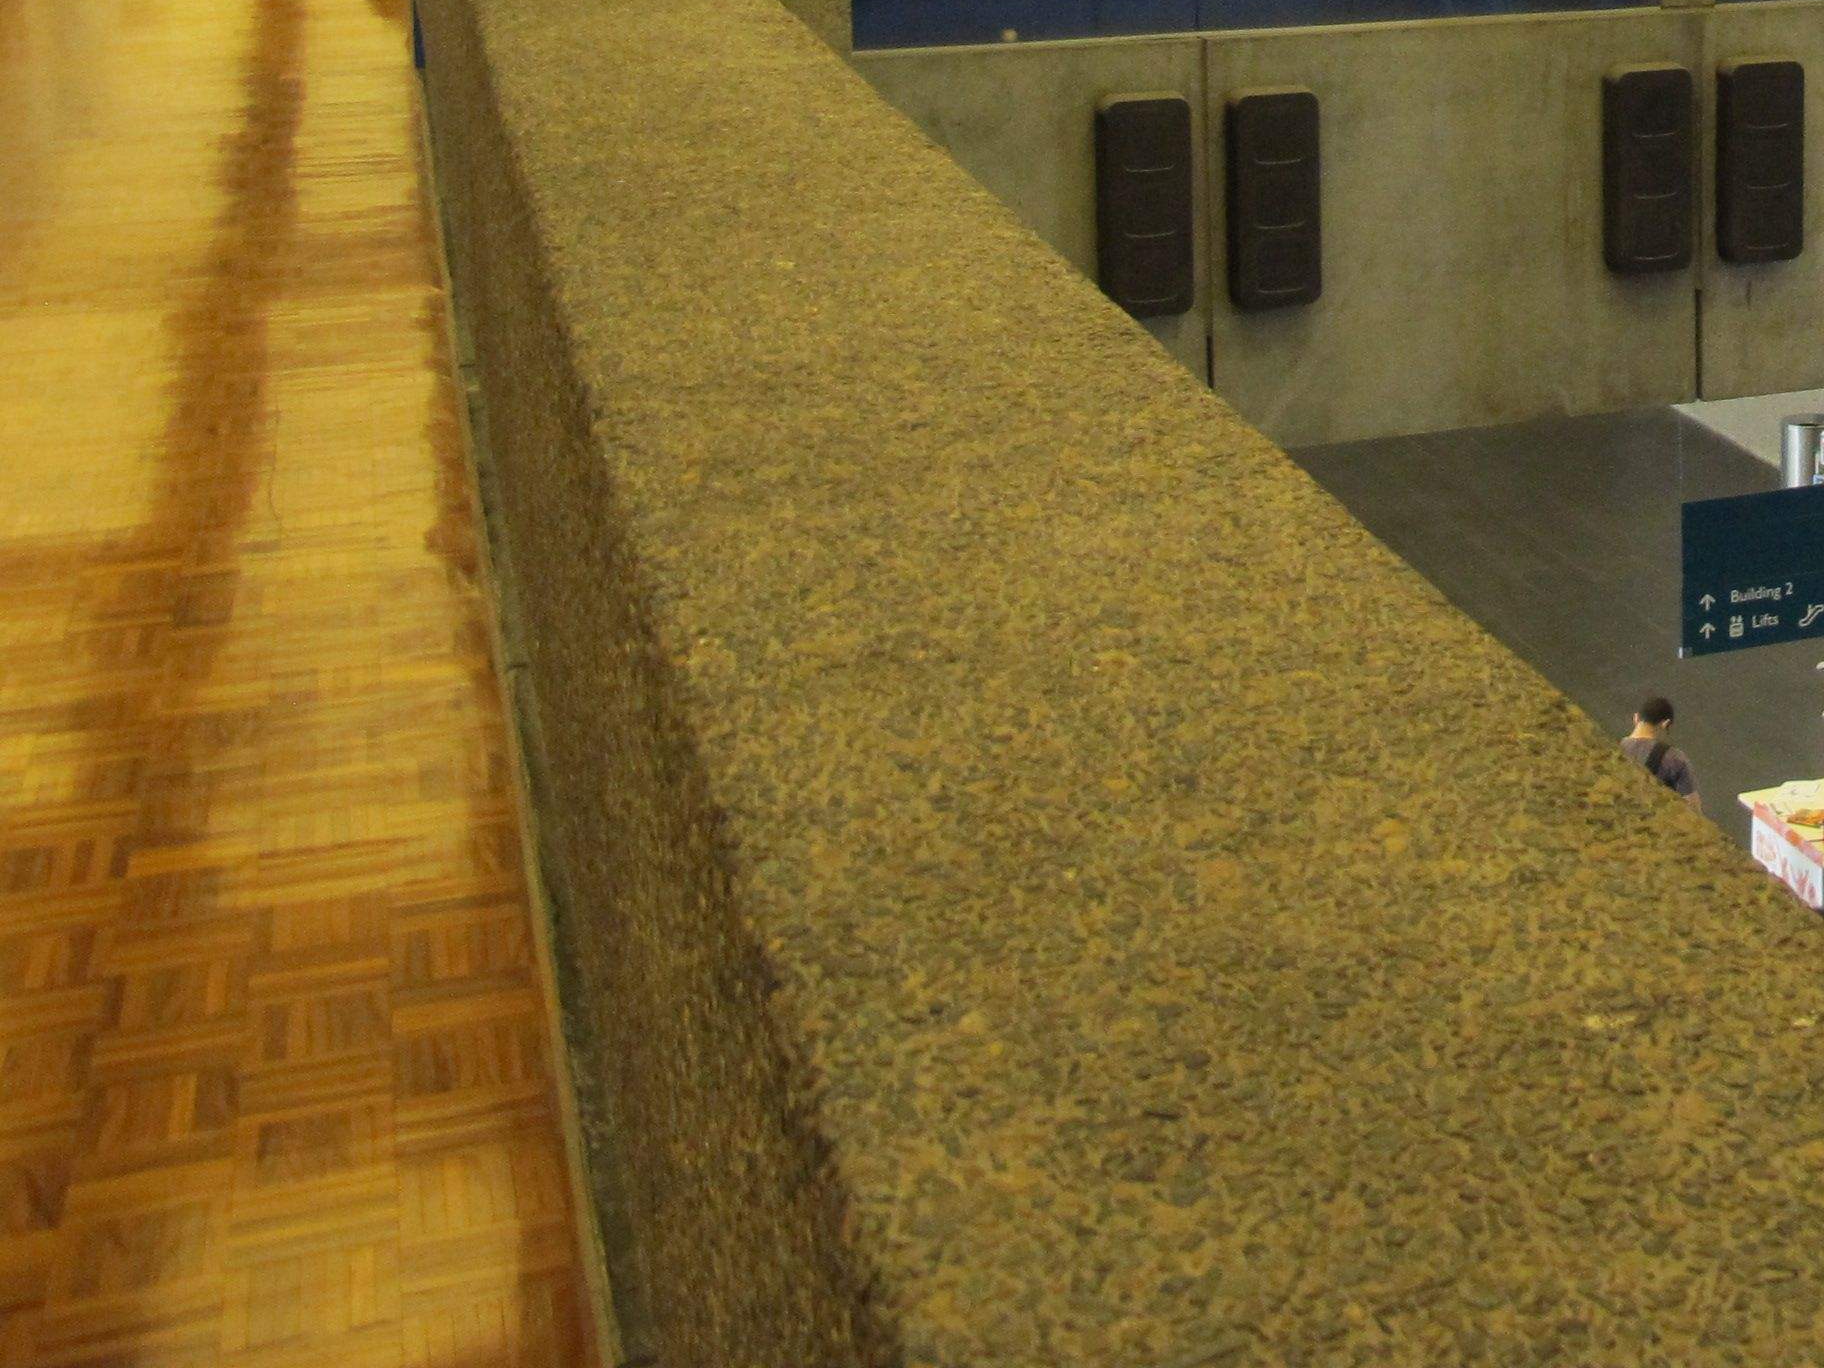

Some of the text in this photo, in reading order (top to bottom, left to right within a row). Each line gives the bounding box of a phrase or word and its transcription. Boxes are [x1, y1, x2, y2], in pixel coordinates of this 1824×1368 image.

[1730, 581, 1794, 605] Building 2
[1751, 614, 1779, 629] Lifts
